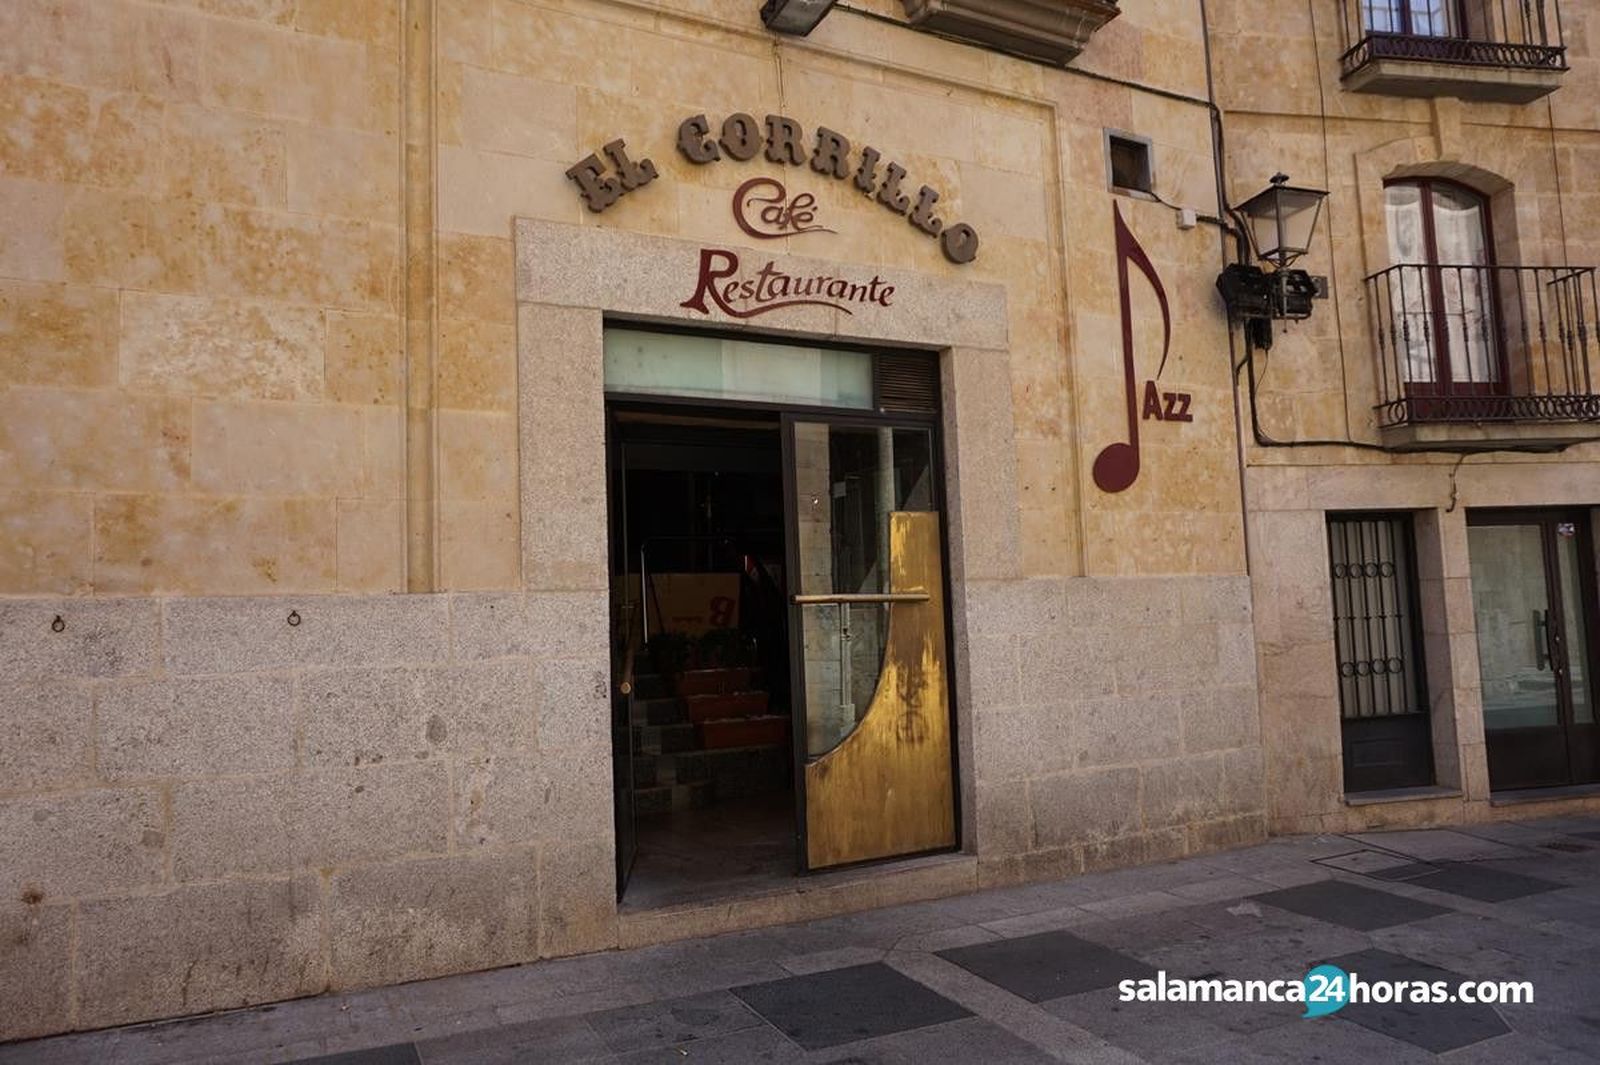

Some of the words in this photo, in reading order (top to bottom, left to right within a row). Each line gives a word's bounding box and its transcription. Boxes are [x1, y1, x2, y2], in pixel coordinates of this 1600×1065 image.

[565, 138, 660, 213] EL
[676, 112, 979, 265] CORRILLO
[732, 177, 837, 239] Café
[680, 248, 896, 319] Restaurante
